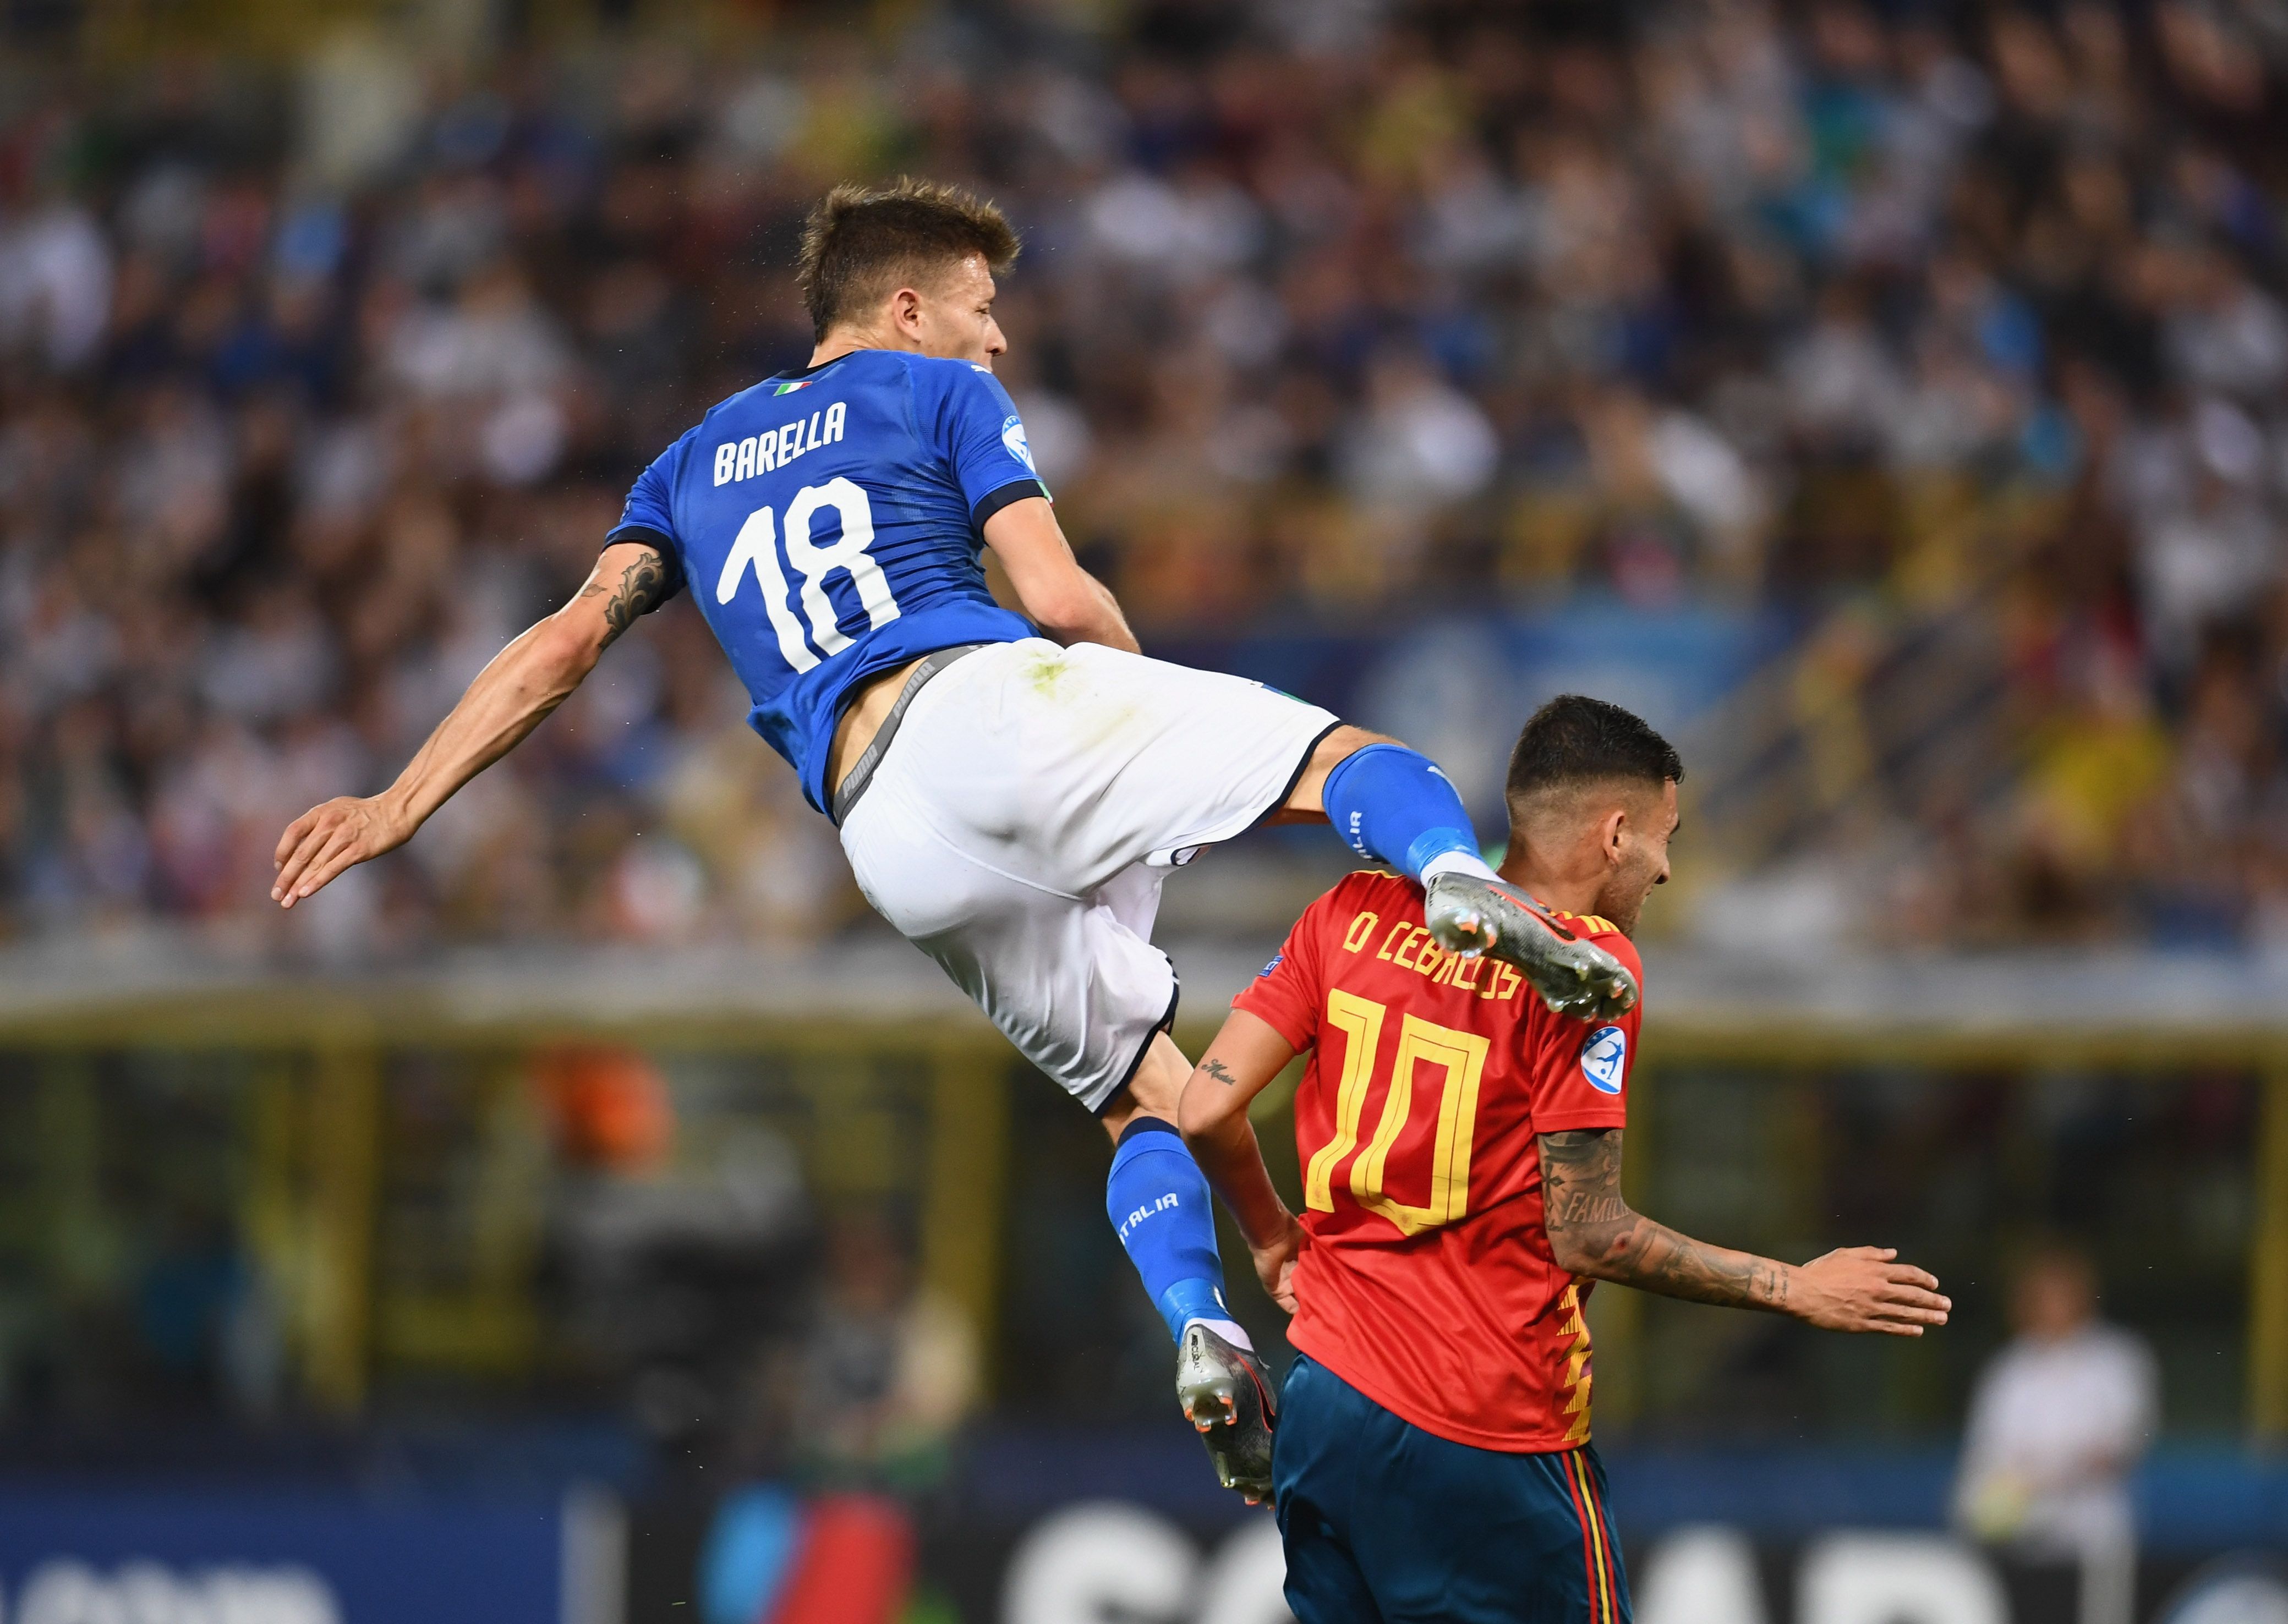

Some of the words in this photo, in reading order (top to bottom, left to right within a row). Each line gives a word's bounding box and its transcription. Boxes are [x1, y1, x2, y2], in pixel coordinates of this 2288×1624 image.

[714, 402, 846, 487] BARELLA
[716, 476, 901, 674] 18
[1305, 988, 1491, 1236] 10
[1119, 1192, 1179, 1246] ITALIA
